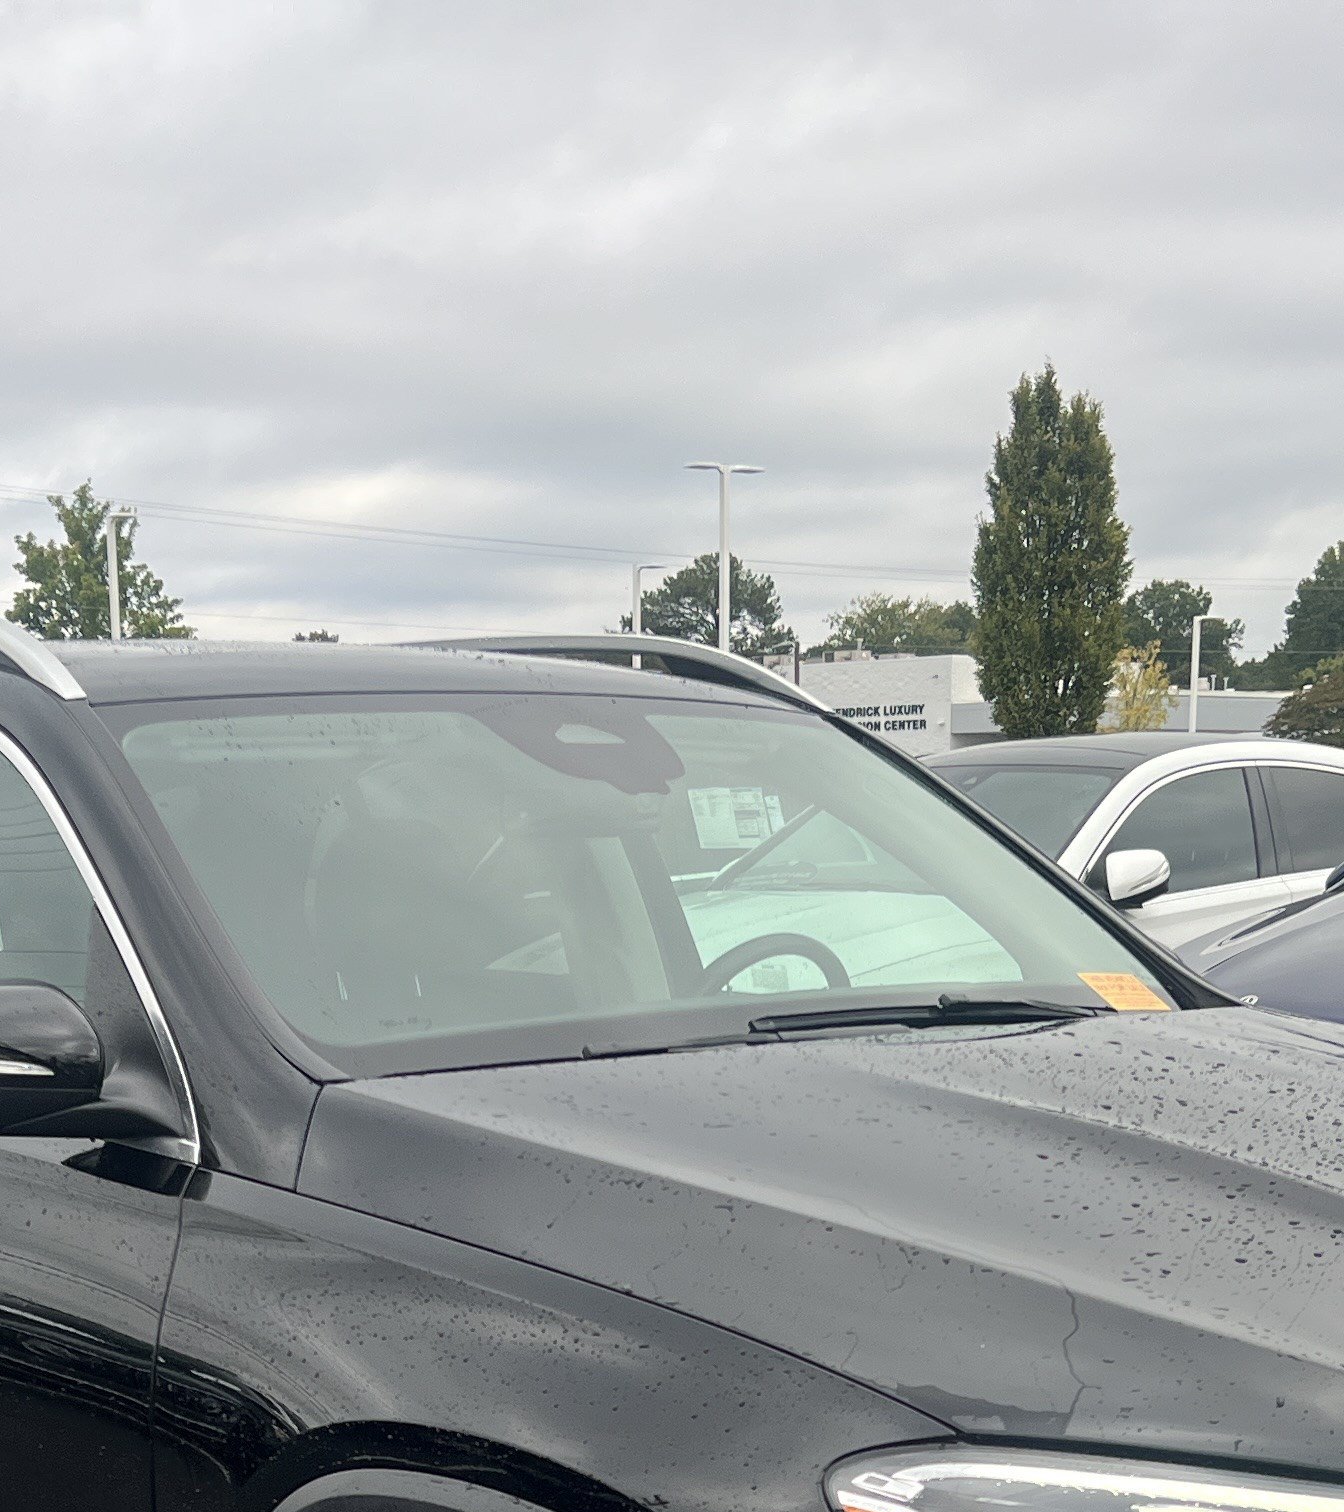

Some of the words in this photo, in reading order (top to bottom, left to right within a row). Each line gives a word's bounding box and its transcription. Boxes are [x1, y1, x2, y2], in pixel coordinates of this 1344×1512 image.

[834, 706, 881, 718] ENDRICK
[883, 704, 925, 716] LUXURY
[884, 719, 927, 731] CENTER
